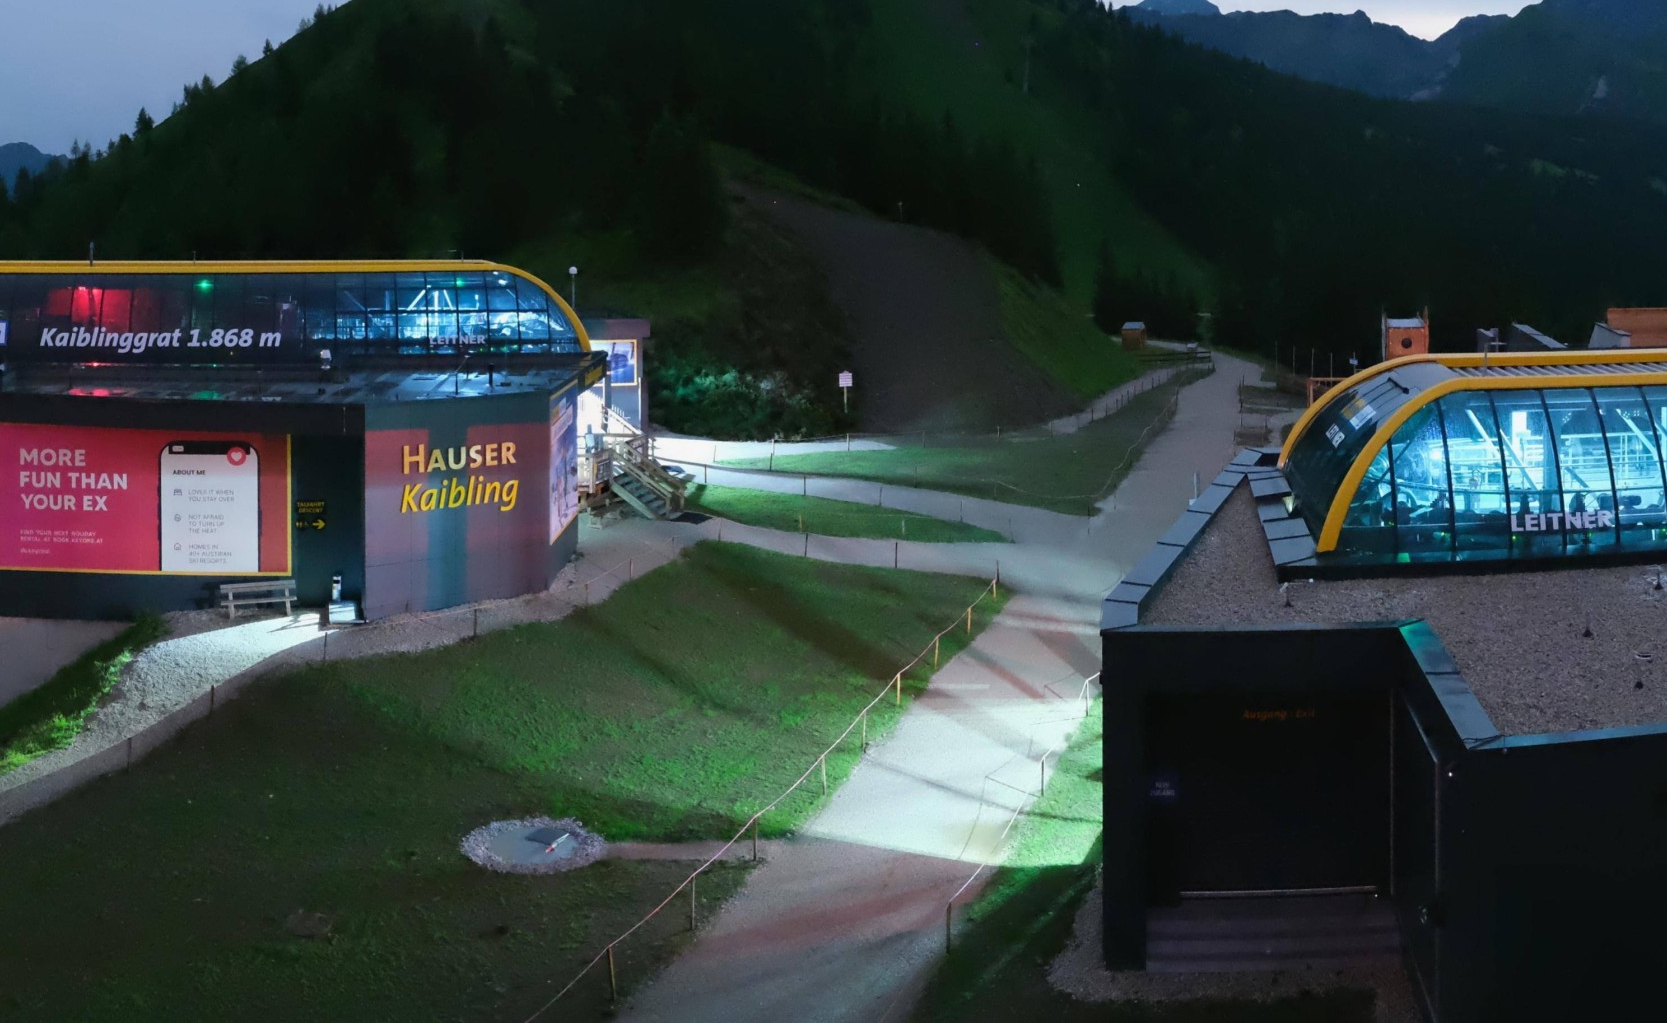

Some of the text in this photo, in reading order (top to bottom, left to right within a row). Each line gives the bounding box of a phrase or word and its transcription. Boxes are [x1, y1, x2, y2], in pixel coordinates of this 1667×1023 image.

[40, 327, 282, 353] Kaiblinggrat 1.868 m
[429, 334, 486, 345] LEITNER
[20, 448, 86, 467] MORE
[402, 441, 517, 475] HAUSER
[20, 471, 128, 489] FUN THAN
[21, 493, 108, 511] YOUR EX
[401, 476, 519, 514] Kaibling
[1510, 509, 1614, 532] LEITNER
